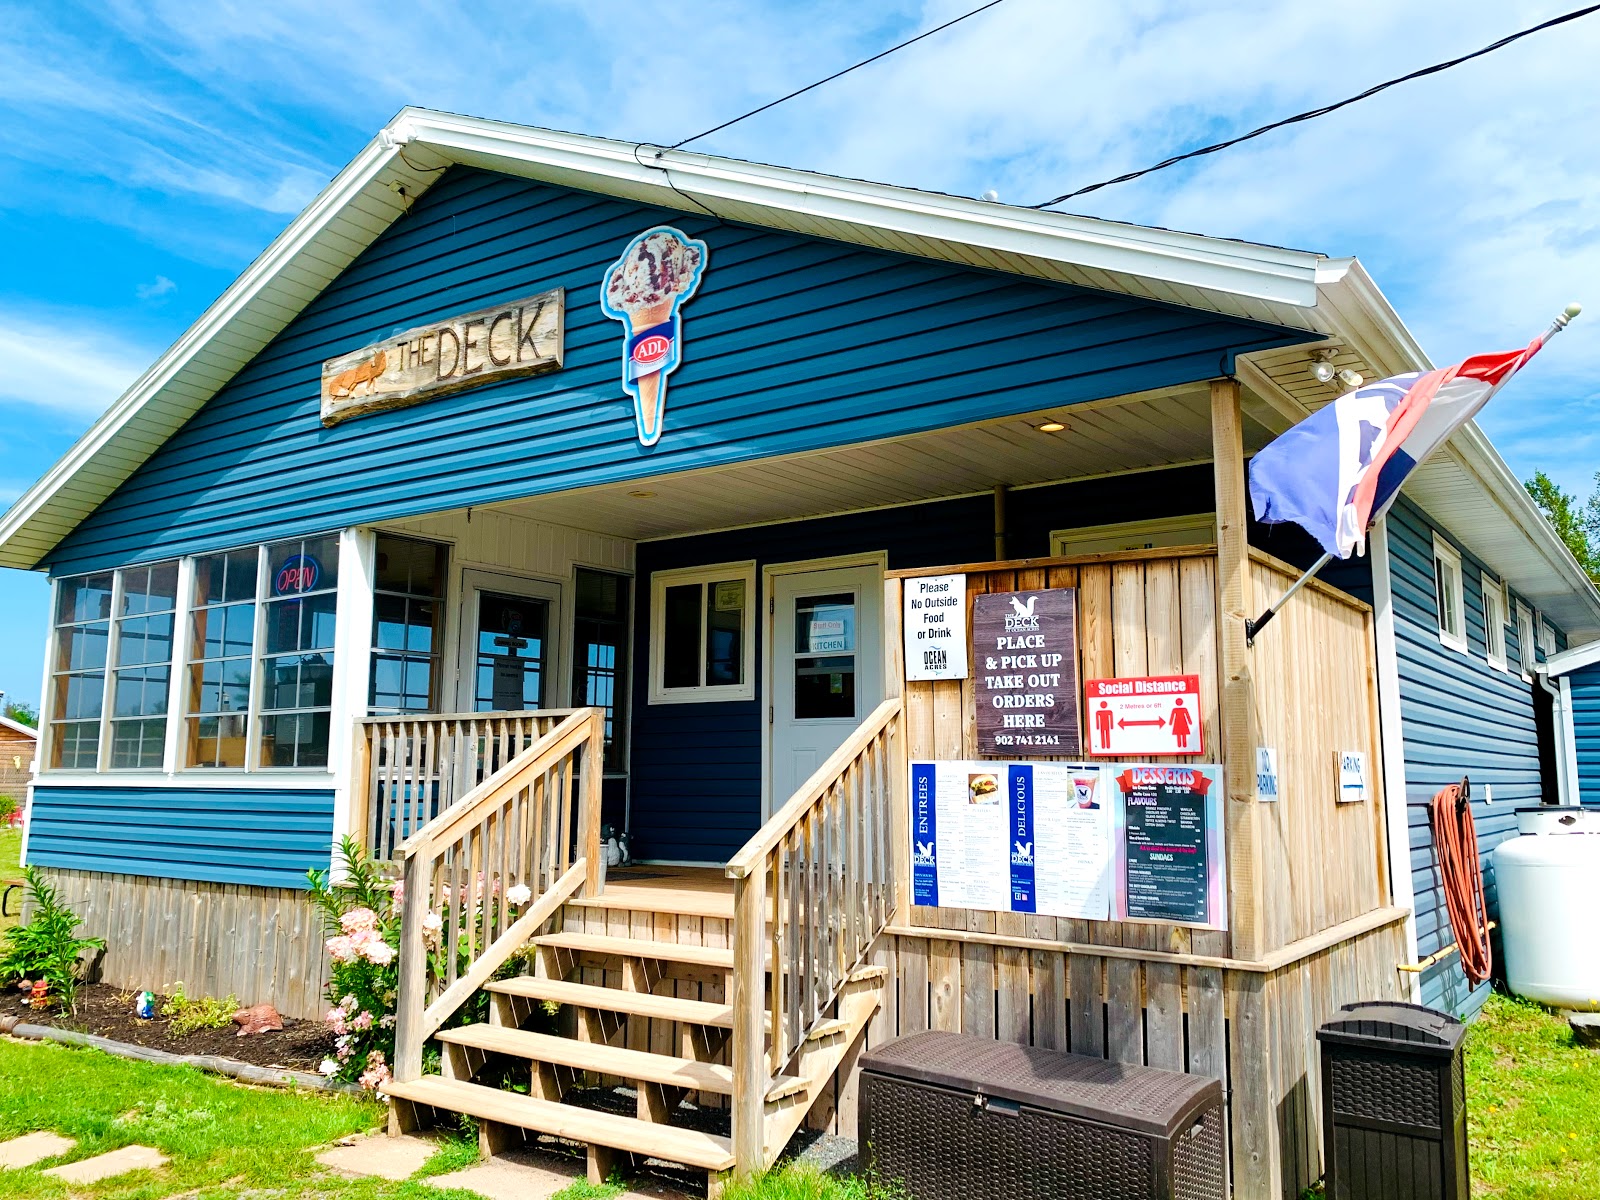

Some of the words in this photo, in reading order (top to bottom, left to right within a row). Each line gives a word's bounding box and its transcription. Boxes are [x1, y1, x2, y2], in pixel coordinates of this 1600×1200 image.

[397, 331, 435, 372] THE
[435, 301, 546, 382] DECK
[637, 340, 666, 359] ADL
[277, 566, 315, 591] OPEN
[920, 582, 949, 594] Please
[911, 599, 922, 610] No
[925, 596, 957, 608] Outside
[923, 612, 944, 624] Food
[1005, 616, 1039, 628] DECK
[917, 631, 926, 639] or
[928, 627, 951, 639] Drink
[812, 640, 843, 650] KITCHEN
[997, 635, 1045, 650] PLACE
[923, 650, 947, 665] OCEAN
[985, 656, 998, 670] &
[1001, 654, 1037, 669] PICK
[1041, 653, 1062, 667] UP
[985, 675, 1024, 690] TAKE
[1027, 673, 1060, 688] OUT
[1098, 681, 1133, 695] Social
[1135, 680, 1186, 694] Distance
[992, 693, 1055, 709] ORDERS
[1003, 714, 1045, 728] HERE
[995, 735, 1014, 745] 902
[1014, 735, 1034, 745] 741
[1034, 734, 1060, 745] 2141
[1132, 767, 1195, 785] DESSERTS
[1257, 774, 1277, 795] PARKING
[918, 777, 928, 834] ENTREES
[1016, 776, 1026, 837] DELICIOUS
[1127, 796, 1157, 806] FLAVOURS
[914, 856, 935, 864] DECK
[1011, 855, 1033, 864] DECK
[1149, 853, 1174, 862] SUNDAES
